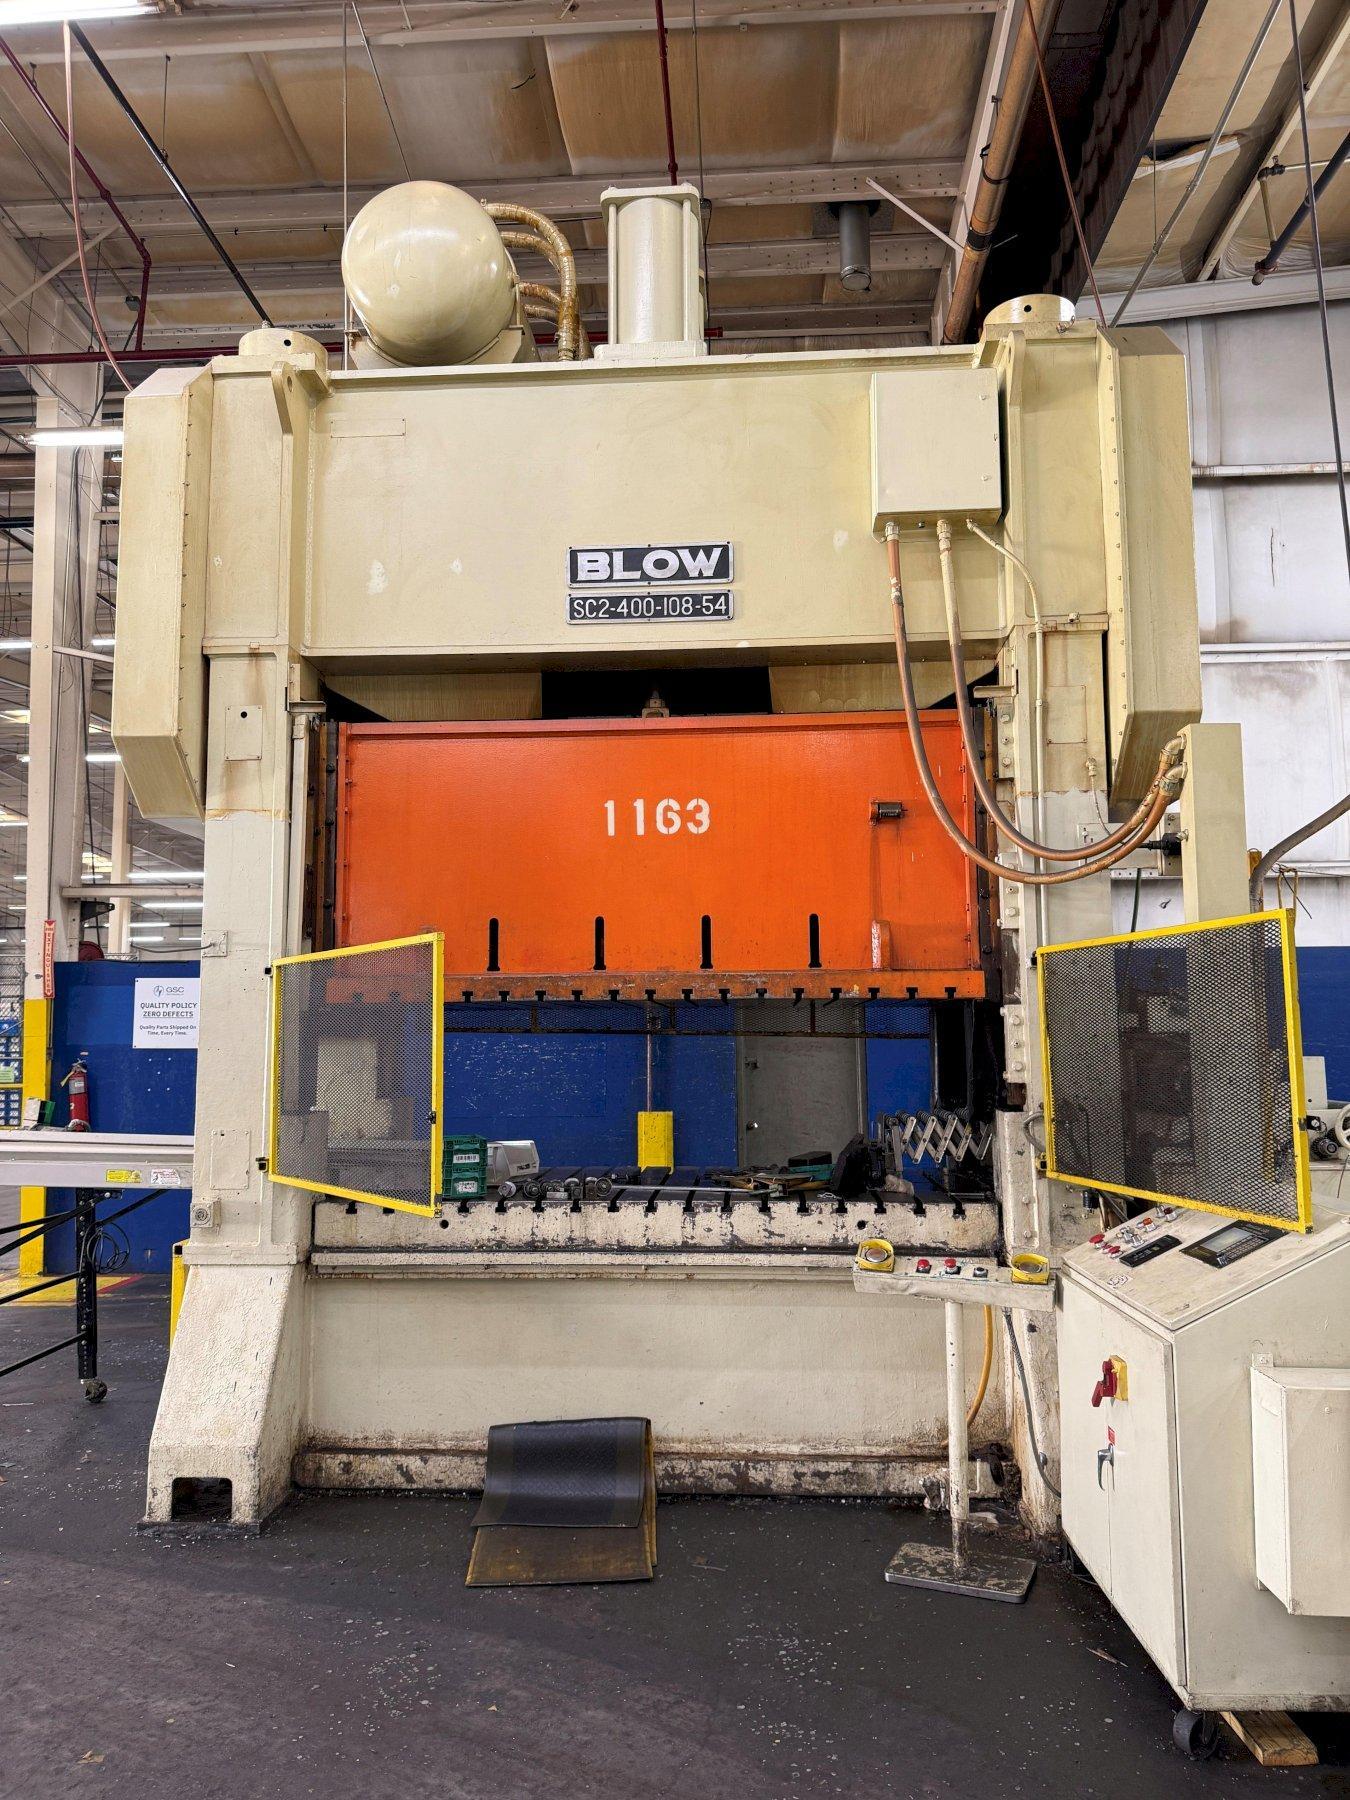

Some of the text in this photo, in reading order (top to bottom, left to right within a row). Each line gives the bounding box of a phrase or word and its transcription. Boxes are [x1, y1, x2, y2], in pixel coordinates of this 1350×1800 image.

[577, 547, 723, 581] BLOW
[604, 797, 711, 837] 1163
[140, 1002, 170, 1010] QUALITY
